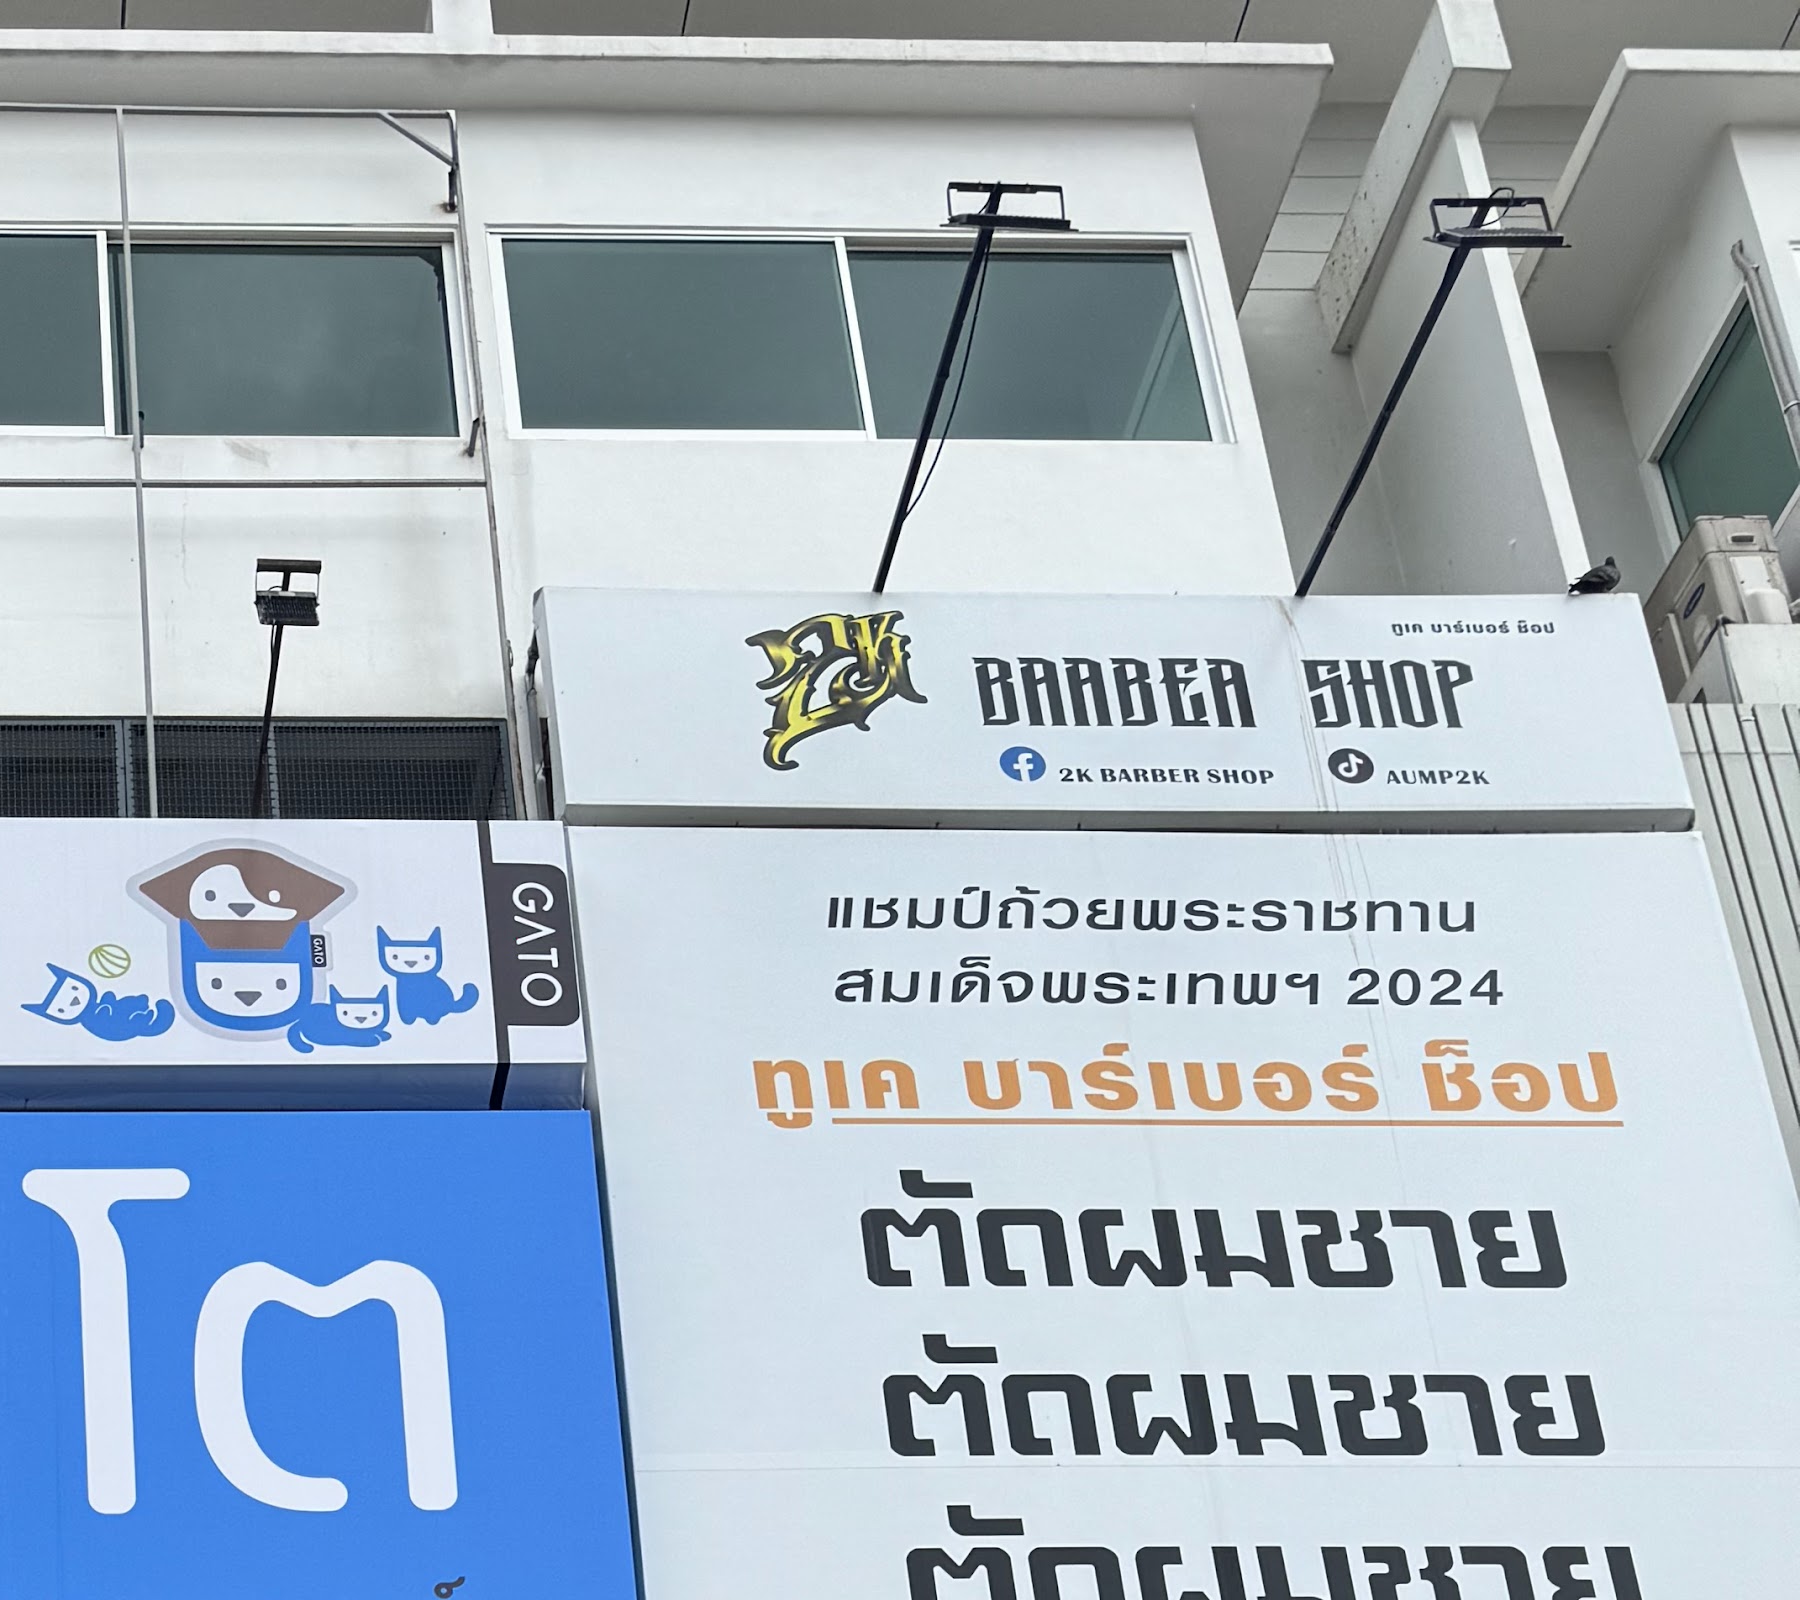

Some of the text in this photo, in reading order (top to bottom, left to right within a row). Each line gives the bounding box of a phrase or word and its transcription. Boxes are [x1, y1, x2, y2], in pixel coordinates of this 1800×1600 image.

[1301, 658, 1474, 730] SHOP
[1059, 766, 1275, 786] 2K BARBER SHOP
[1386, 769, 1491, 786] AUMP2K
[827, 886, 1477, 933] แชมป์ถ้วยพระราชทาน
[834, 956, 1504, 1006] สมเด็จพระเทพฯ 2024
[753, 1038, 1625, 1128] ทูเค บาร์เบอร์ ช็อป
[860, 1169, 1568, 1290] ตัดผมชาย
[882, 1334, 1606, 1457] ตัดผมชาย
